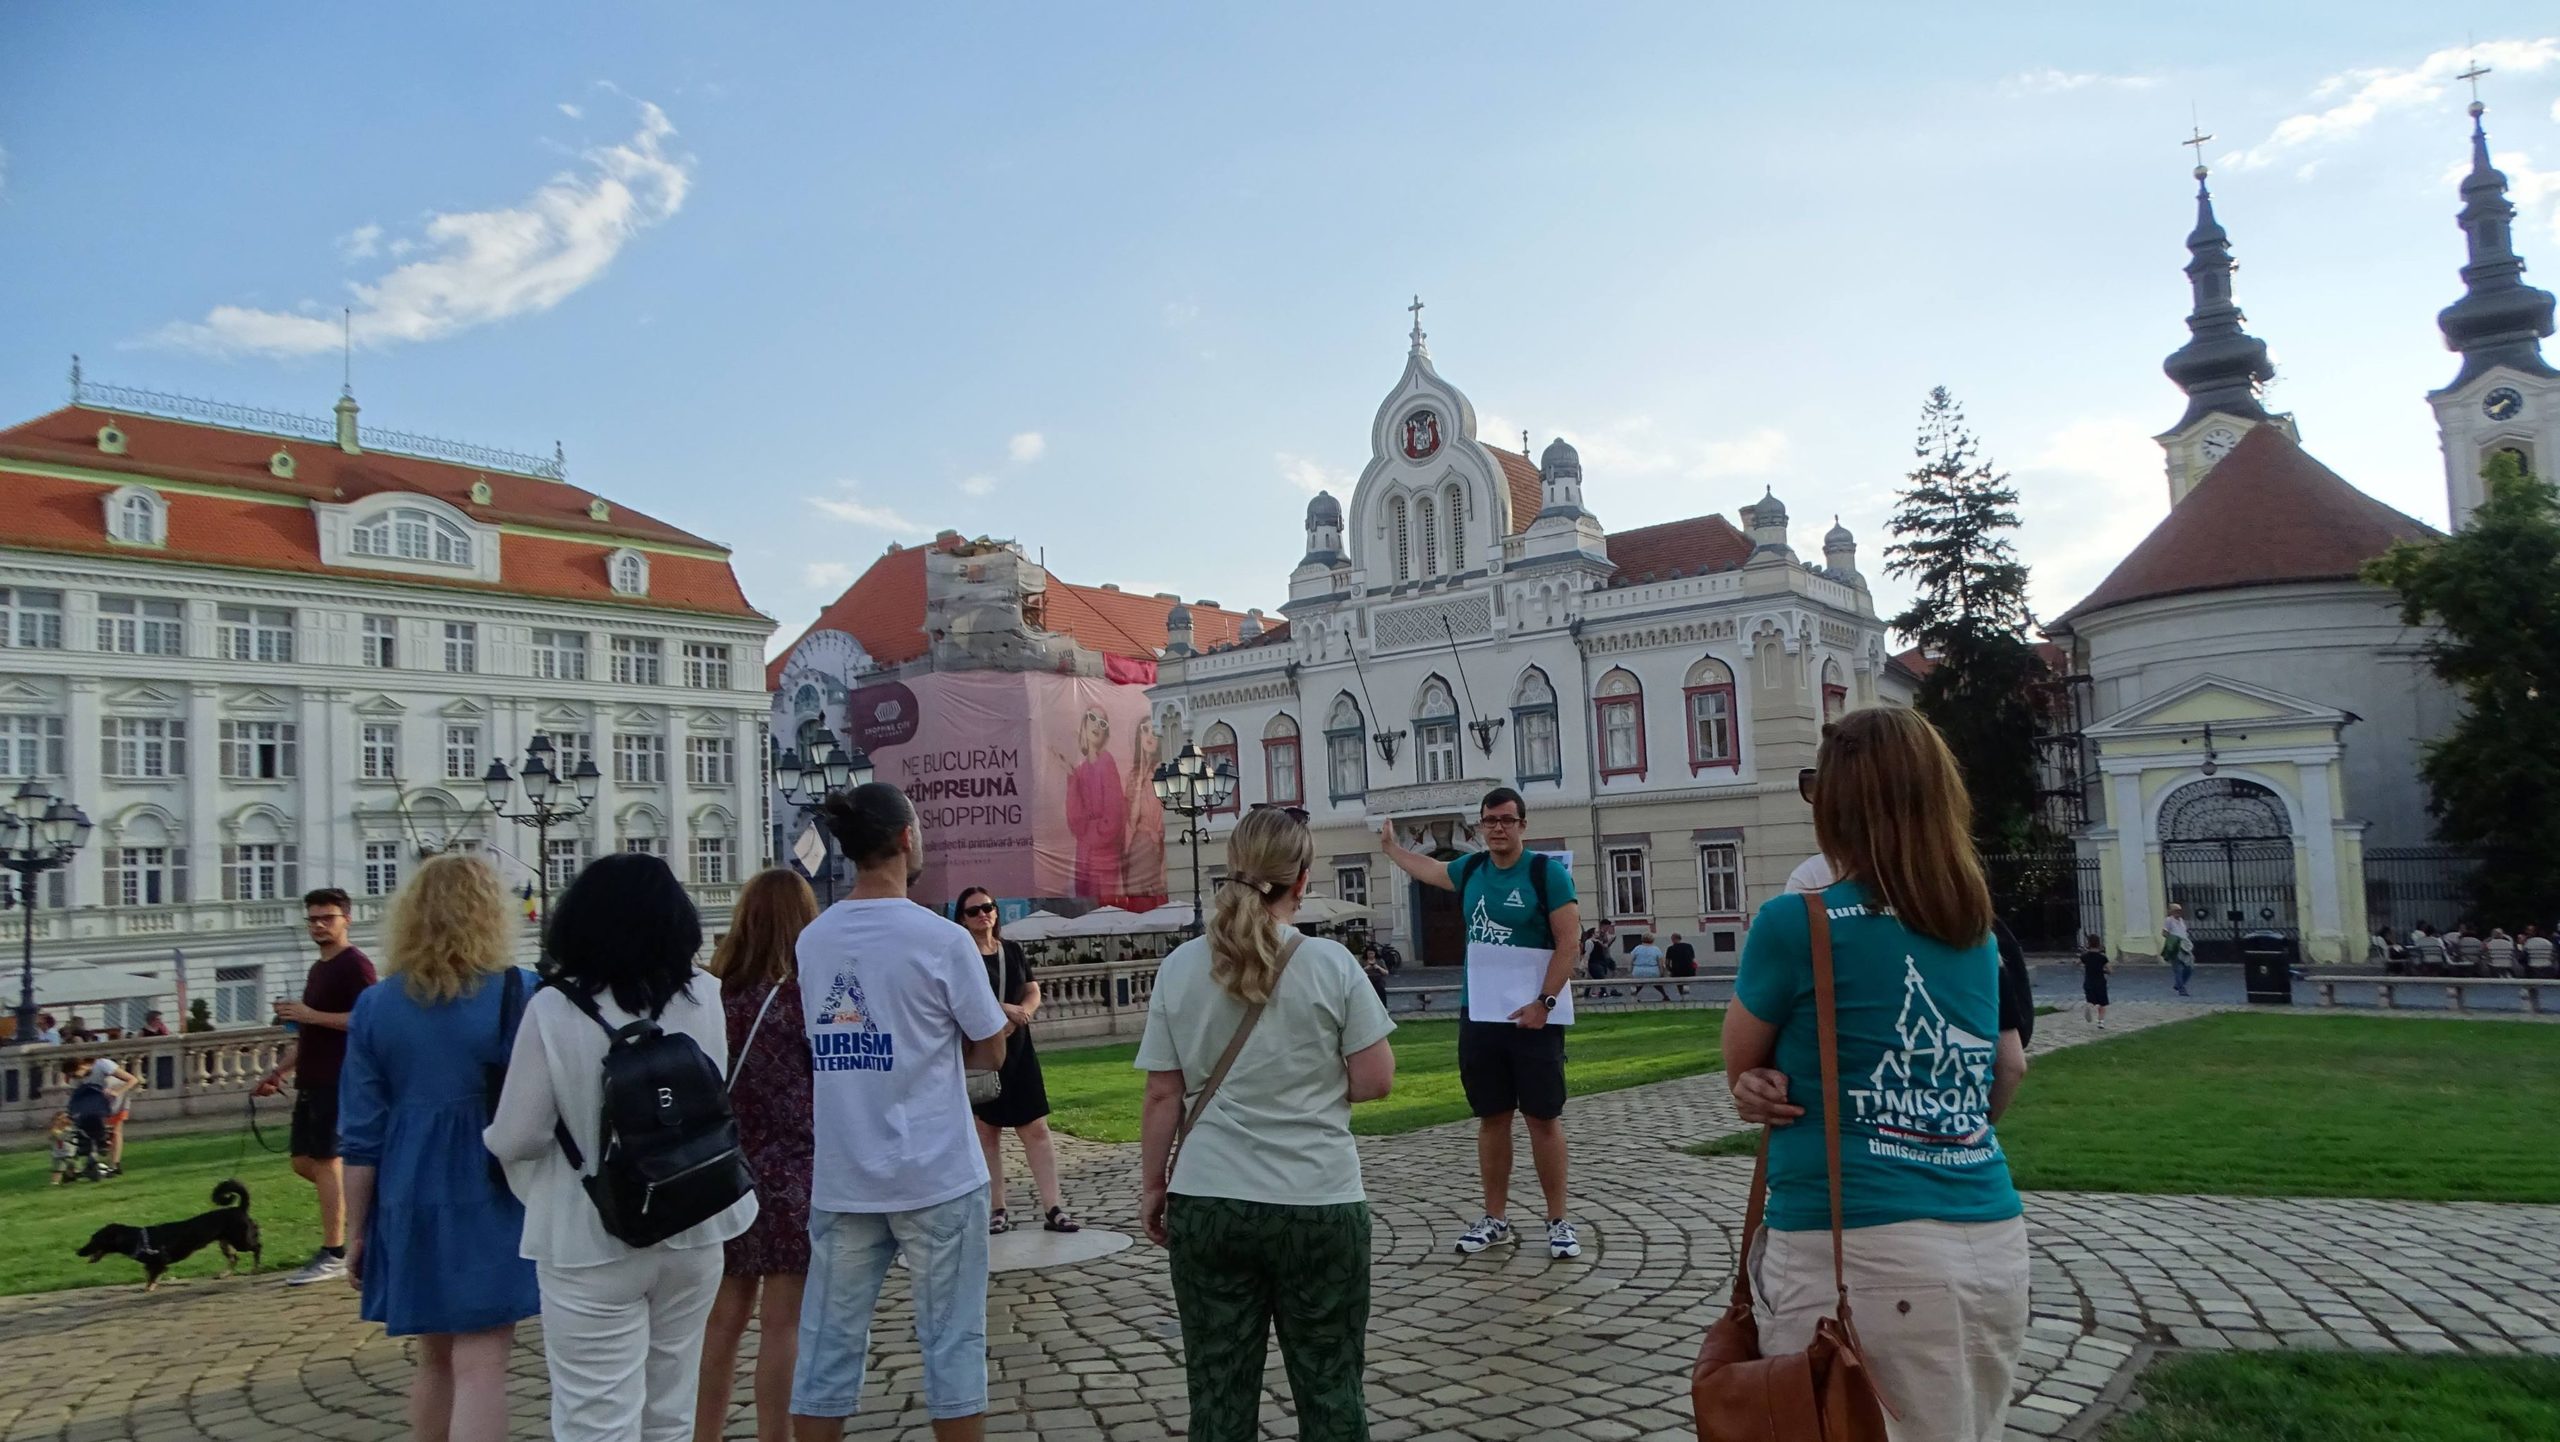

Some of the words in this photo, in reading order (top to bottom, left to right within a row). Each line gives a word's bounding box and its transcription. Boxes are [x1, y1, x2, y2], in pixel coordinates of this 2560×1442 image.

[903, 756, 920, 776] NE
[924, 745, 1018, 774] BUCURĂM
[904, 772, 1018, 802] #ÎMPREUNĂ
[922, 804, 1022, 829] SHOPPING
[813, 1031, 893, 1056] URISM
[813, 1055, 894, 1071] LTERNATIV
